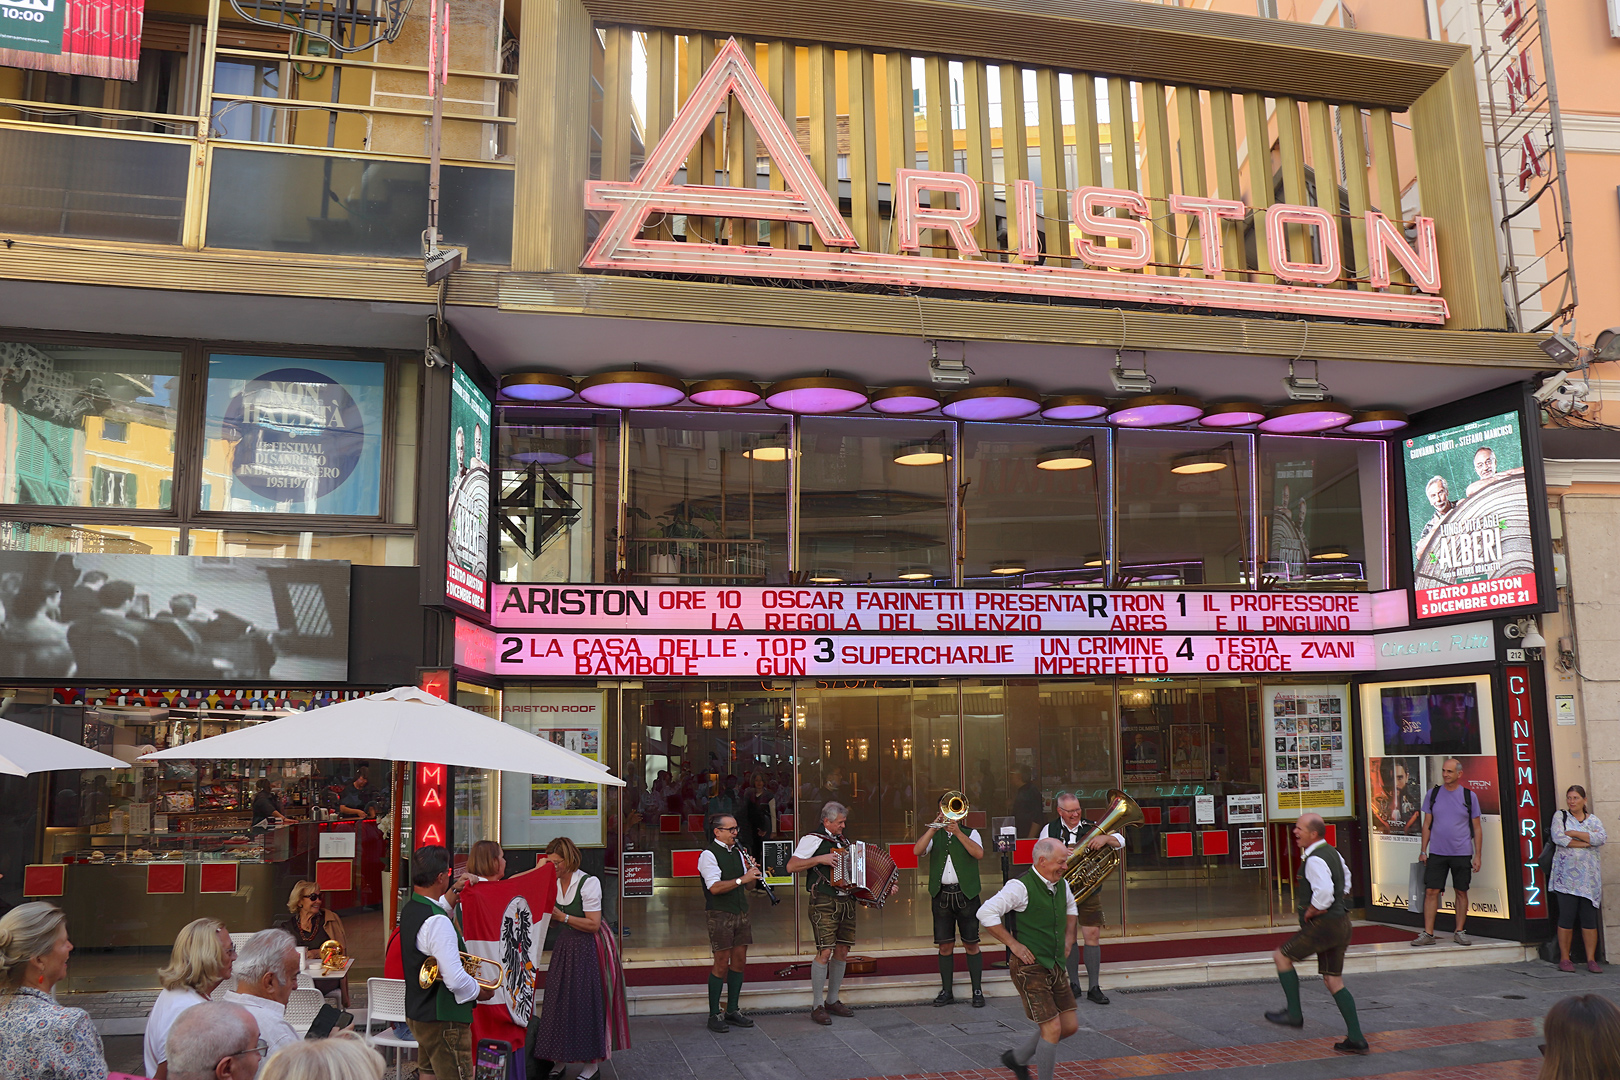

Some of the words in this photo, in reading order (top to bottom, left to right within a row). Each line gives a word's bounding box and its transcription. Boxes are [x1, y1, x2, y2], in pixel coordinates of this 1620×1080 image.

[2, 7, 44, 22] 10:00
[578, 36, 1444, 310] ARISTON
[270, 381, 323, 405] NON
[272, 442, 325, 454] FESTIVAL
[1410, 444, 1434, 460] GIOVANNI
[1436, 440, 1454, 452] STORTI
[1460, 434, 1483, 446] STEFANO
[1484, 424, 1513, 440] MANCUSO
[240, 464, 252, 475] IN
[270, 453, 326, 466] SANREMO
[1438, 528, 1502, 570] ALBERI
[1426, 585, 1468, 600] TEATRO
[1471, 577, 1522, 594] ARISTON
[501, 587, 648, 616] ARISTON
[658, 591, 706, 610] ORE
[716, 590, 742, 608] 10
[762, 590, 844, 610] OSCAR
[856, 591, 964, 610] FARINETTI
[976, 593, 1087, 612] PRESENTA
[1109, 594, 1164, 612] TRON
[1176, 594, 1186, 616] 1
[1204, 594, 1220, 612] IL
[1230, 594, 1359, 612] PROFESSORE
[1422, 604, 1429, 615] 5
[1430, 596, 1488, 613] DICEMBRE
[1490, 592, 1515, 606] ORE
[1518, 590, 1529, 602] 21
[712, 612, 744, 631] LA
[765, 613, 862, 632] REGOLA
[878, 614, 922, 632] DEL
[936, 613, 1042, 632] SILENZIO
[1110, 614, 1168, 632] ARES
[1216, 616, 1228, 632] E
[1238, 616, 1254, 632] IL
[1262, 616, 1350, 632] PINGUINO
[500, 637, 524, 663] 2
[530, 638, 564, 657] LA
[573, 638, 642, 658] CASA
[756, 638, 806, 656] TOP
[814, 638, 835, 662] 3
[842, 645, 1014, 664] SUPERCHARLIE
[1040, 638, 1069, 656] UN
[1078, 638, 1164, 656] CRIMINE
[1176, 637, 1194, 660] 4
[1216, 638, 1278, 654] TESTA
[1300, 642, 1354, 659] ZVANI
[575, 656, 699, 676] BAMBOLE
[756, 657, 806, 676] GUN
[1034, 656, 1169, 674] IMPERFETTO
[1206, 654, 1220, 672] O
[1228, 654, 1292, 671] CROCE
[1509, 676, 1535, 808] CINEMA
[1521, 818, 1541, 906] RITZ
[1471, 902, 1498, 913] CINEMA
